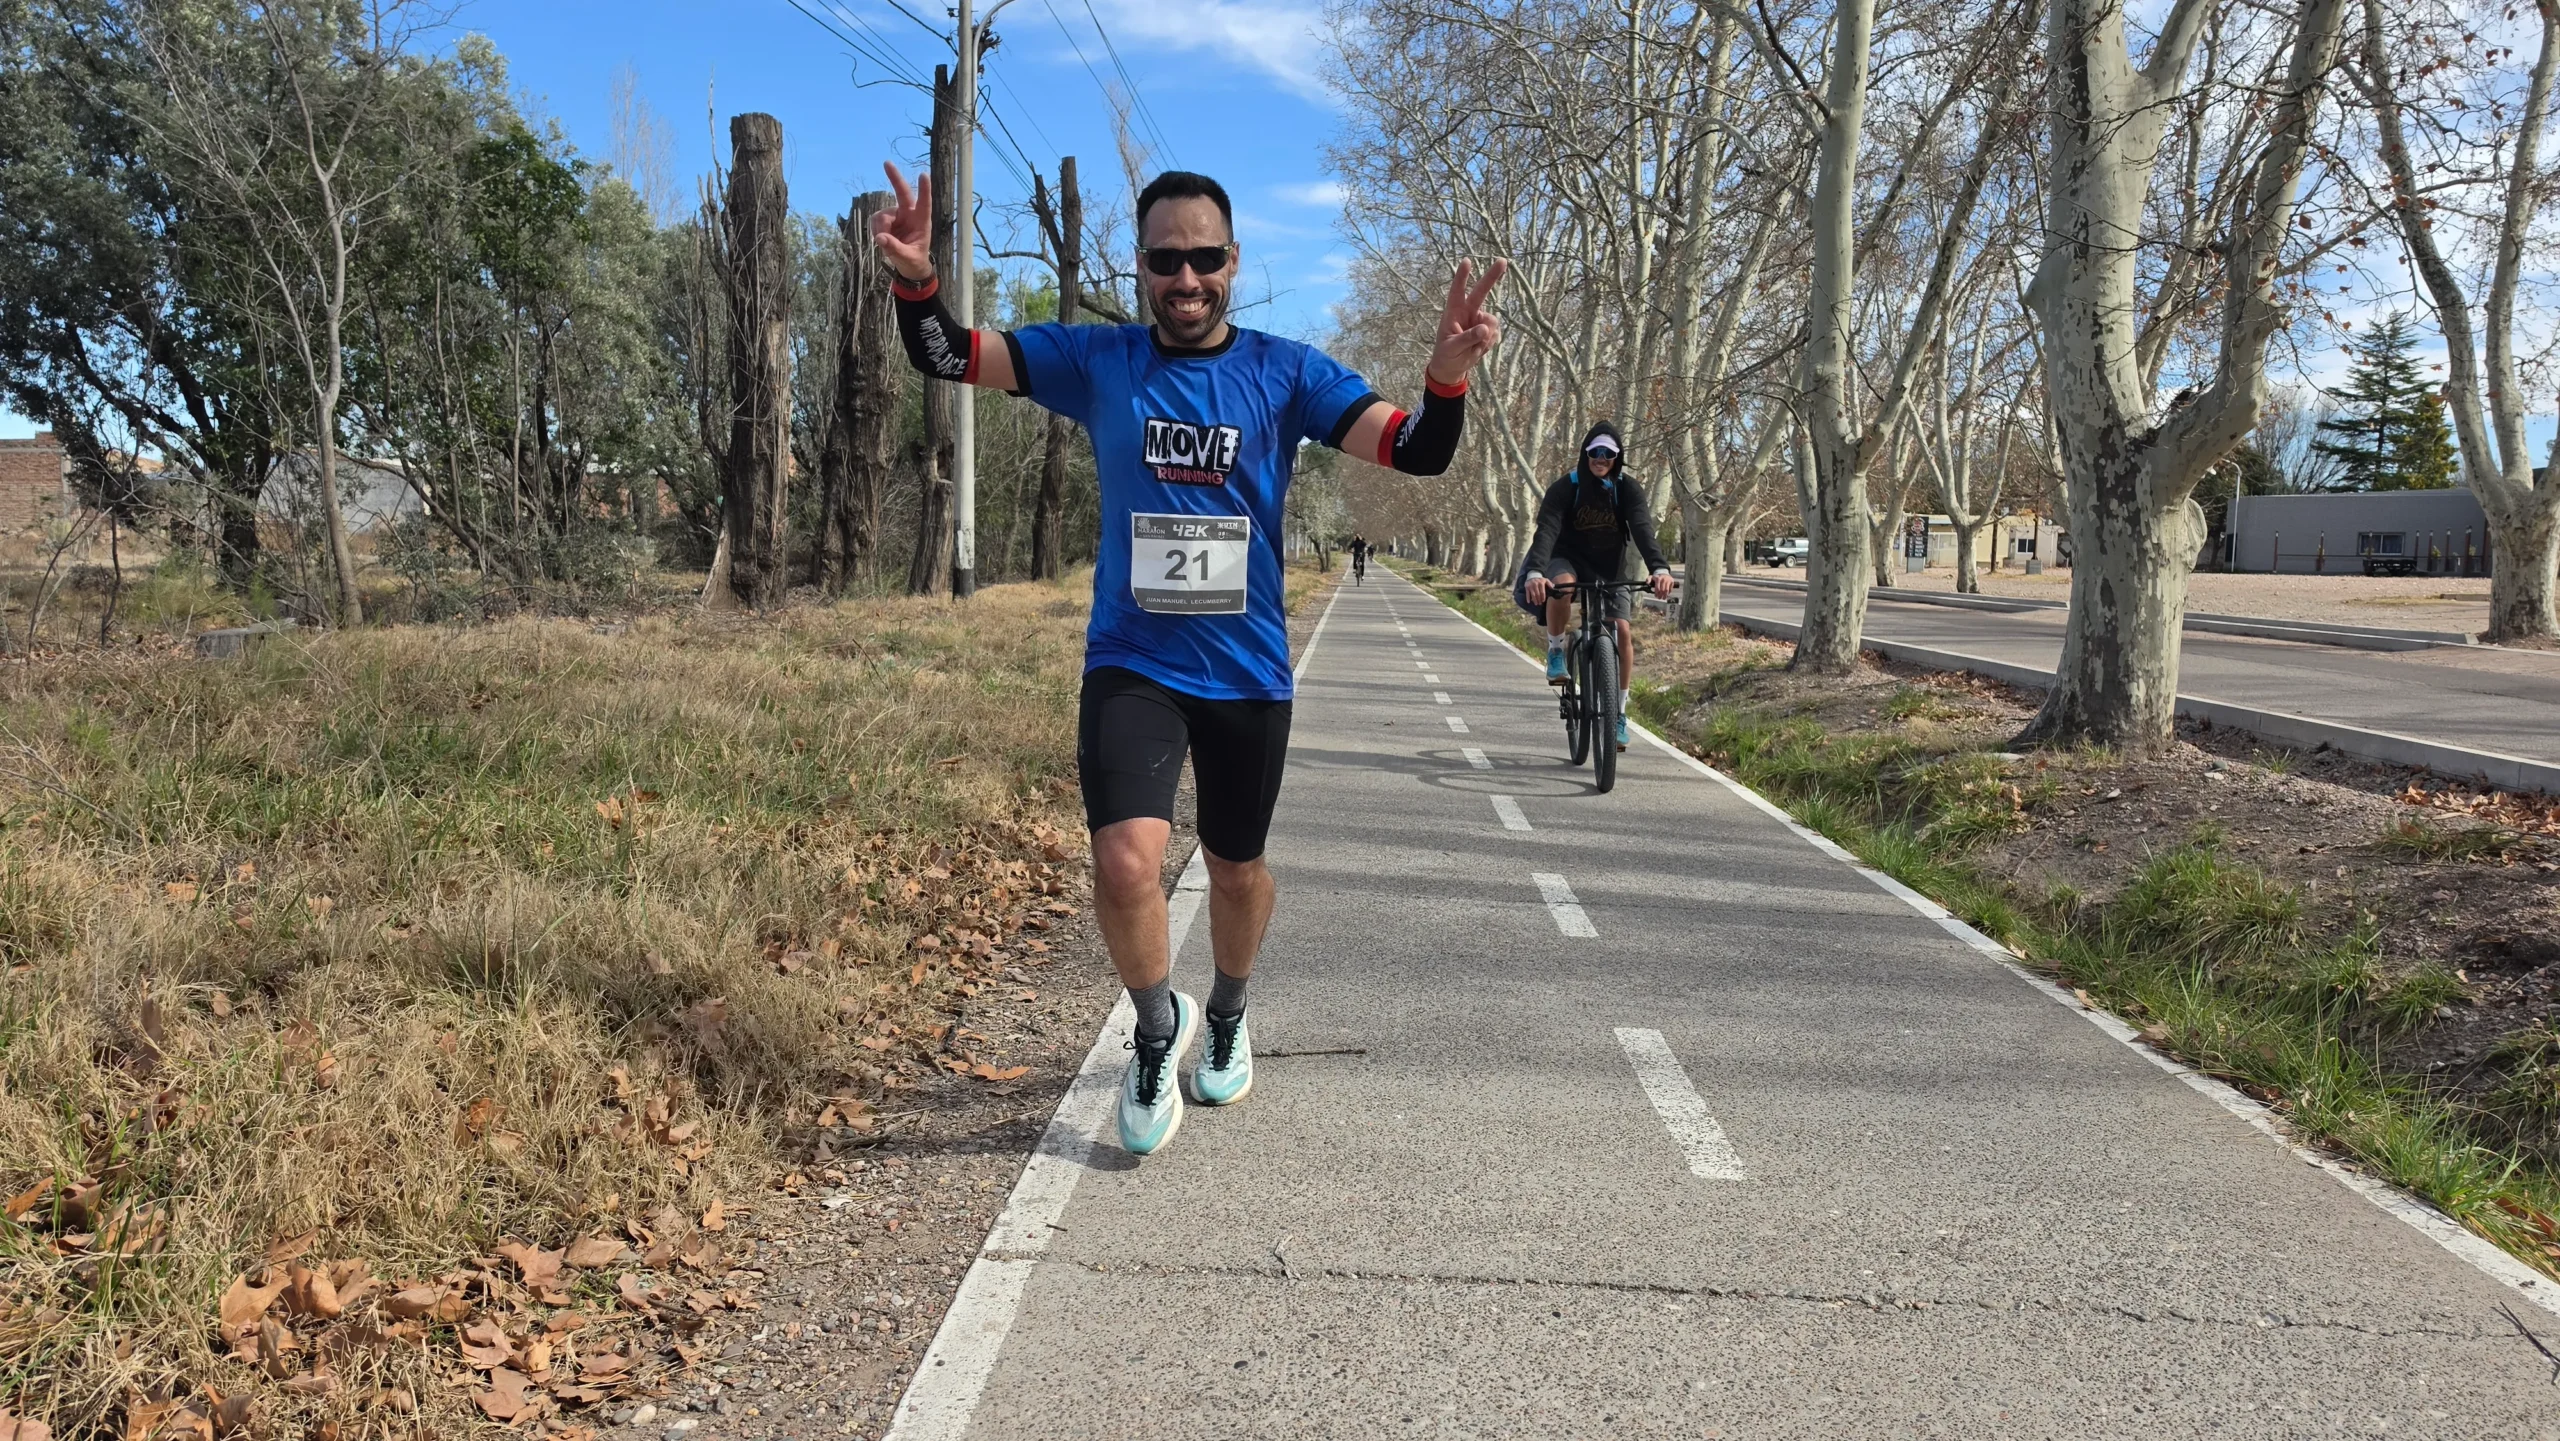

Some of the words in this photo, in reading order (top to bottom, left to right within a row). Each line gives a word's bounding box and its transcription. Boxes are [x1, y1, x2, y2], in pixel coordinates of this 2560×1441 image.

[1145, 418, 1240, 472] MOVE
[1155, 466, 1224, 485] RUNNING
[1173, 524, 1210, 538] 42K
[1164, 549, 1209, 581] 21
